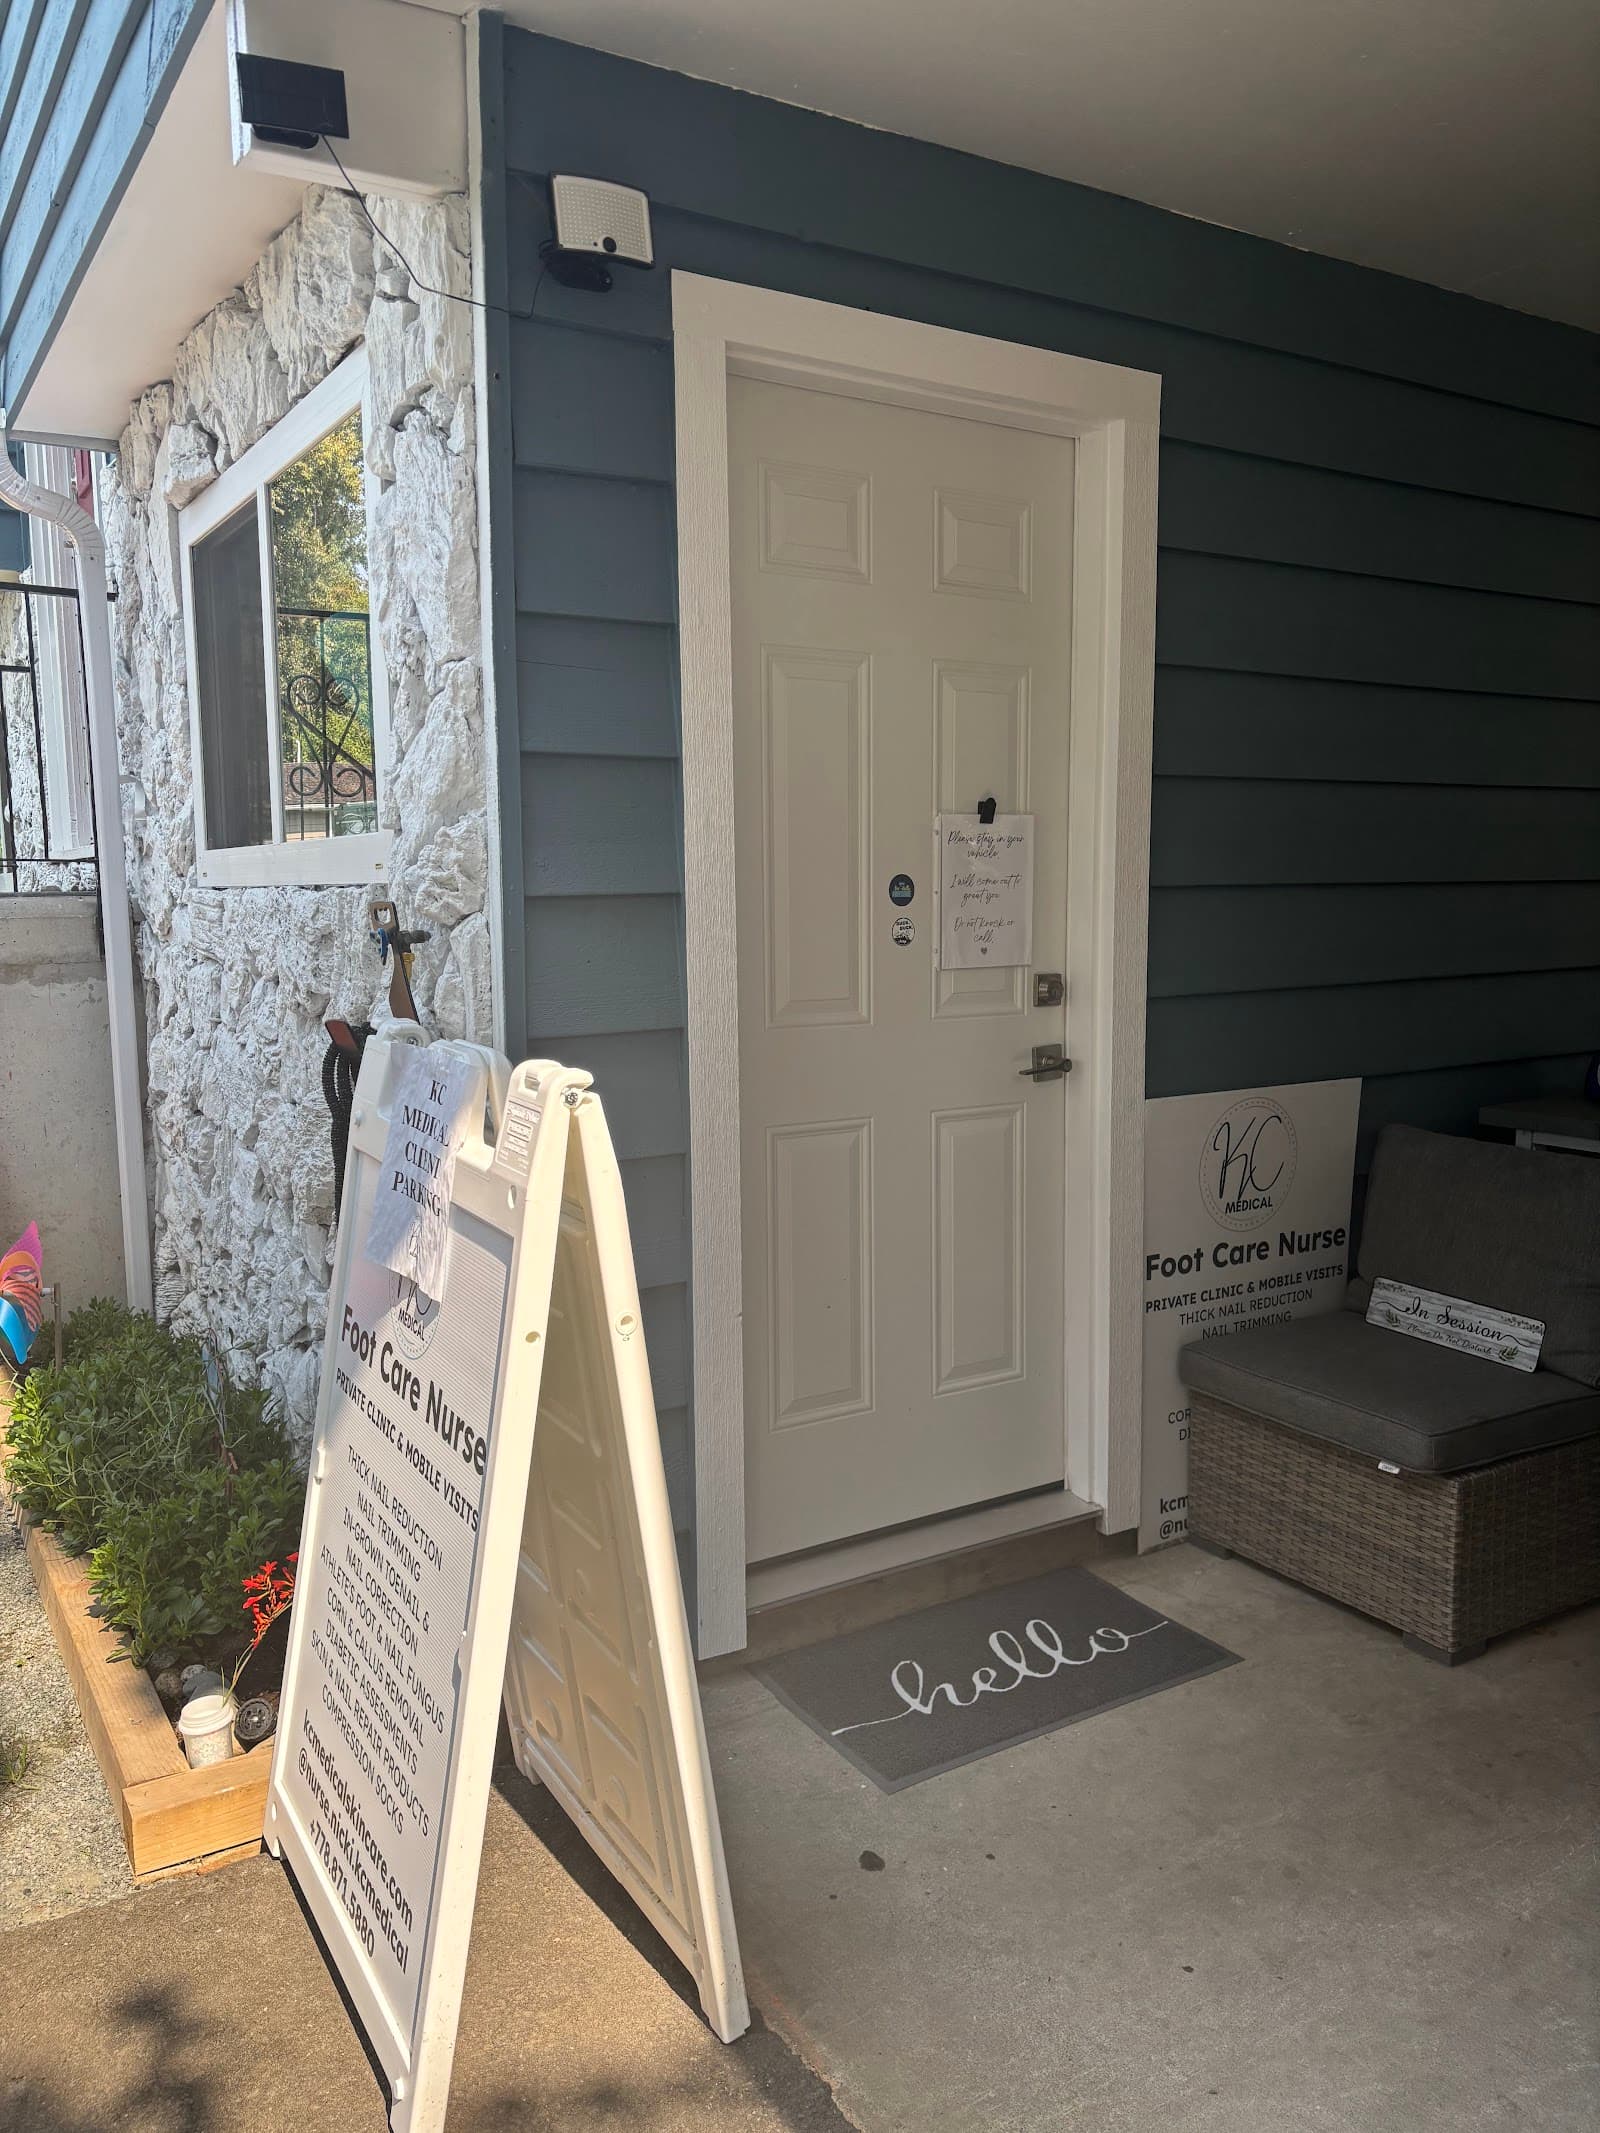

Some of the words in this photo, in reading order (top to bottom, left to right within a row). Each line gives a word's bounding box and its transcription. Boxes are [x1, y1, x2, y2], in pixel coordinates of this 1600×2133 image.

[977, 832, 994, 848] stay
[402, 1105, 450, 1147] MEDICAL
[429, 1080, 447, 1105] KC
[391, 1170, 442, 1217] PARKING
[404, 1140, 442, 1180] CLIENT
[1214, 1115, 1284, 1200] KC
[1224, 1196, 1273, 1215] MEDICAL
[1146, 1248, 1204, 1281] Foot
[1212, 1240, 1270, 1268] Care
[1278, 1227, 1346, 1257] Nurse
[1146, 1292, 1198, 1314] PRIVATE
[1200, 1283, 1244, 1302] CLINIC
[1246, 1281, 1256, 1294] &
[1259, 1272, 1302, 1292] MOBILE
[1306, 1264, 1344, 1282] VISITS
[1180, 1309, 1216, 1326] THICK
[1218, 1303, 1246, 1318] NAIL
[1250, 1288, 1313, 1312] REDUCTION
[398, 1308, 425, 1342] MEDICAL
[1202, 1325, 1230, 1341] NAIL
[1234, 1310, 1292, 1333] TRIMMING
[342, 1304, 376, 1368] Foot
[380, 1341, 420, 1412] Care
[426, 1380, 487, 1476] Nurse
[336, 1368, 365, 1412] PRIVATE
[366, 1402, 396, 1444] CLINIC
[396, 1432, 404, 1454] &
[405, 1440, 440, 1493] MOBILE
[444, 1482, 479, 1533] VISITS
[348, 1444, 370, 1486] THICK
[371, 1474, 390, 1510] NAIL
[392, 1496, 442, 1572] REDUCTION
[358, 1490, 375, 1528] NAIL
[378, 1514, 421, 1582] TRIMMING
[344, 1506, 384, 1572] IN-GROWN
[386, 1560, 420, 1622] TOENAIL
[422, 1611, 430, 1635] &
[346, 1544, 364, 1583] NAIL
[365, 1572, 418, 1656] CORRECTION
[320, 1544, 355, 1604] ATHLETE'S
[356, 1593, 376, 1633] FOOT
[376, 1624, 383, 1646] &
[384, 1634, 404, 1678] NAIL
[406, 1666, 444, 1734] FUNGUS
[328, 1587, 347, 1628] CORN
[348, 1618, 354, 1640] &
[354, 1628, 384, 1683] CALLUS
[385, 1672, 424, 1748] REMOVAL
[832, 1619, 1168, 1735] hello
[312, 1630, 328, 1668] SKIN
[328, 1660, 334, 1680] &
[334, 1671, 352, 1710] NAIL
[354, 1699, 382, 1755] REPAIR
[384, 1747, 430, 1838] PRODUCTS
[326, 1619, 360, 1683] DIABETIC
[360, 1674, 418, 1776] ASSESSMENTS
[322, 1684, 375, 1786] COMPRESSION
[376, 1774, 404, 1836] SOCKS
[298, 1747, 409, 1974] @nurse.nicki.kcmedical
[303, 1708, 414, 1934] kcmedicalskincare.com
[310, 1819, 375, 1958] +778.871.5880
